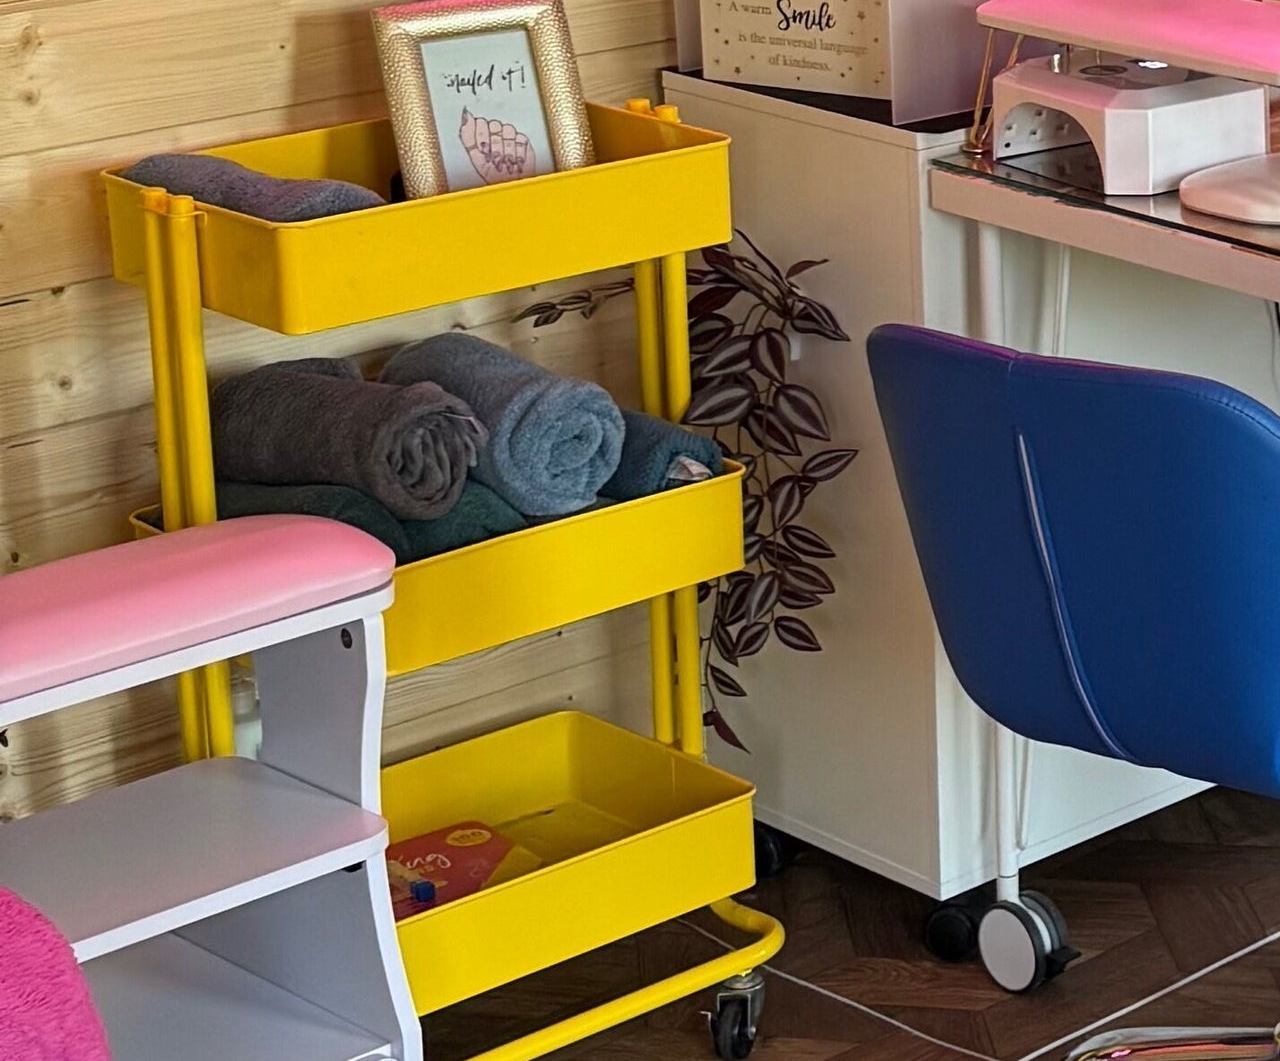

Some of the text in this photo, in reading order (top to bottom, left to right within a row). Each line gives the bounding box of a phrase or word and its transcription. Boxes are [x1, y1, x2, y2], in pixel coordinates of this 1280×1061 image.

[729, 1, 738, 12] A
[740, 4, 772, 16] warm
[739, 31, 870, 56] is the universal language
[768, 54, 781, 66] of
